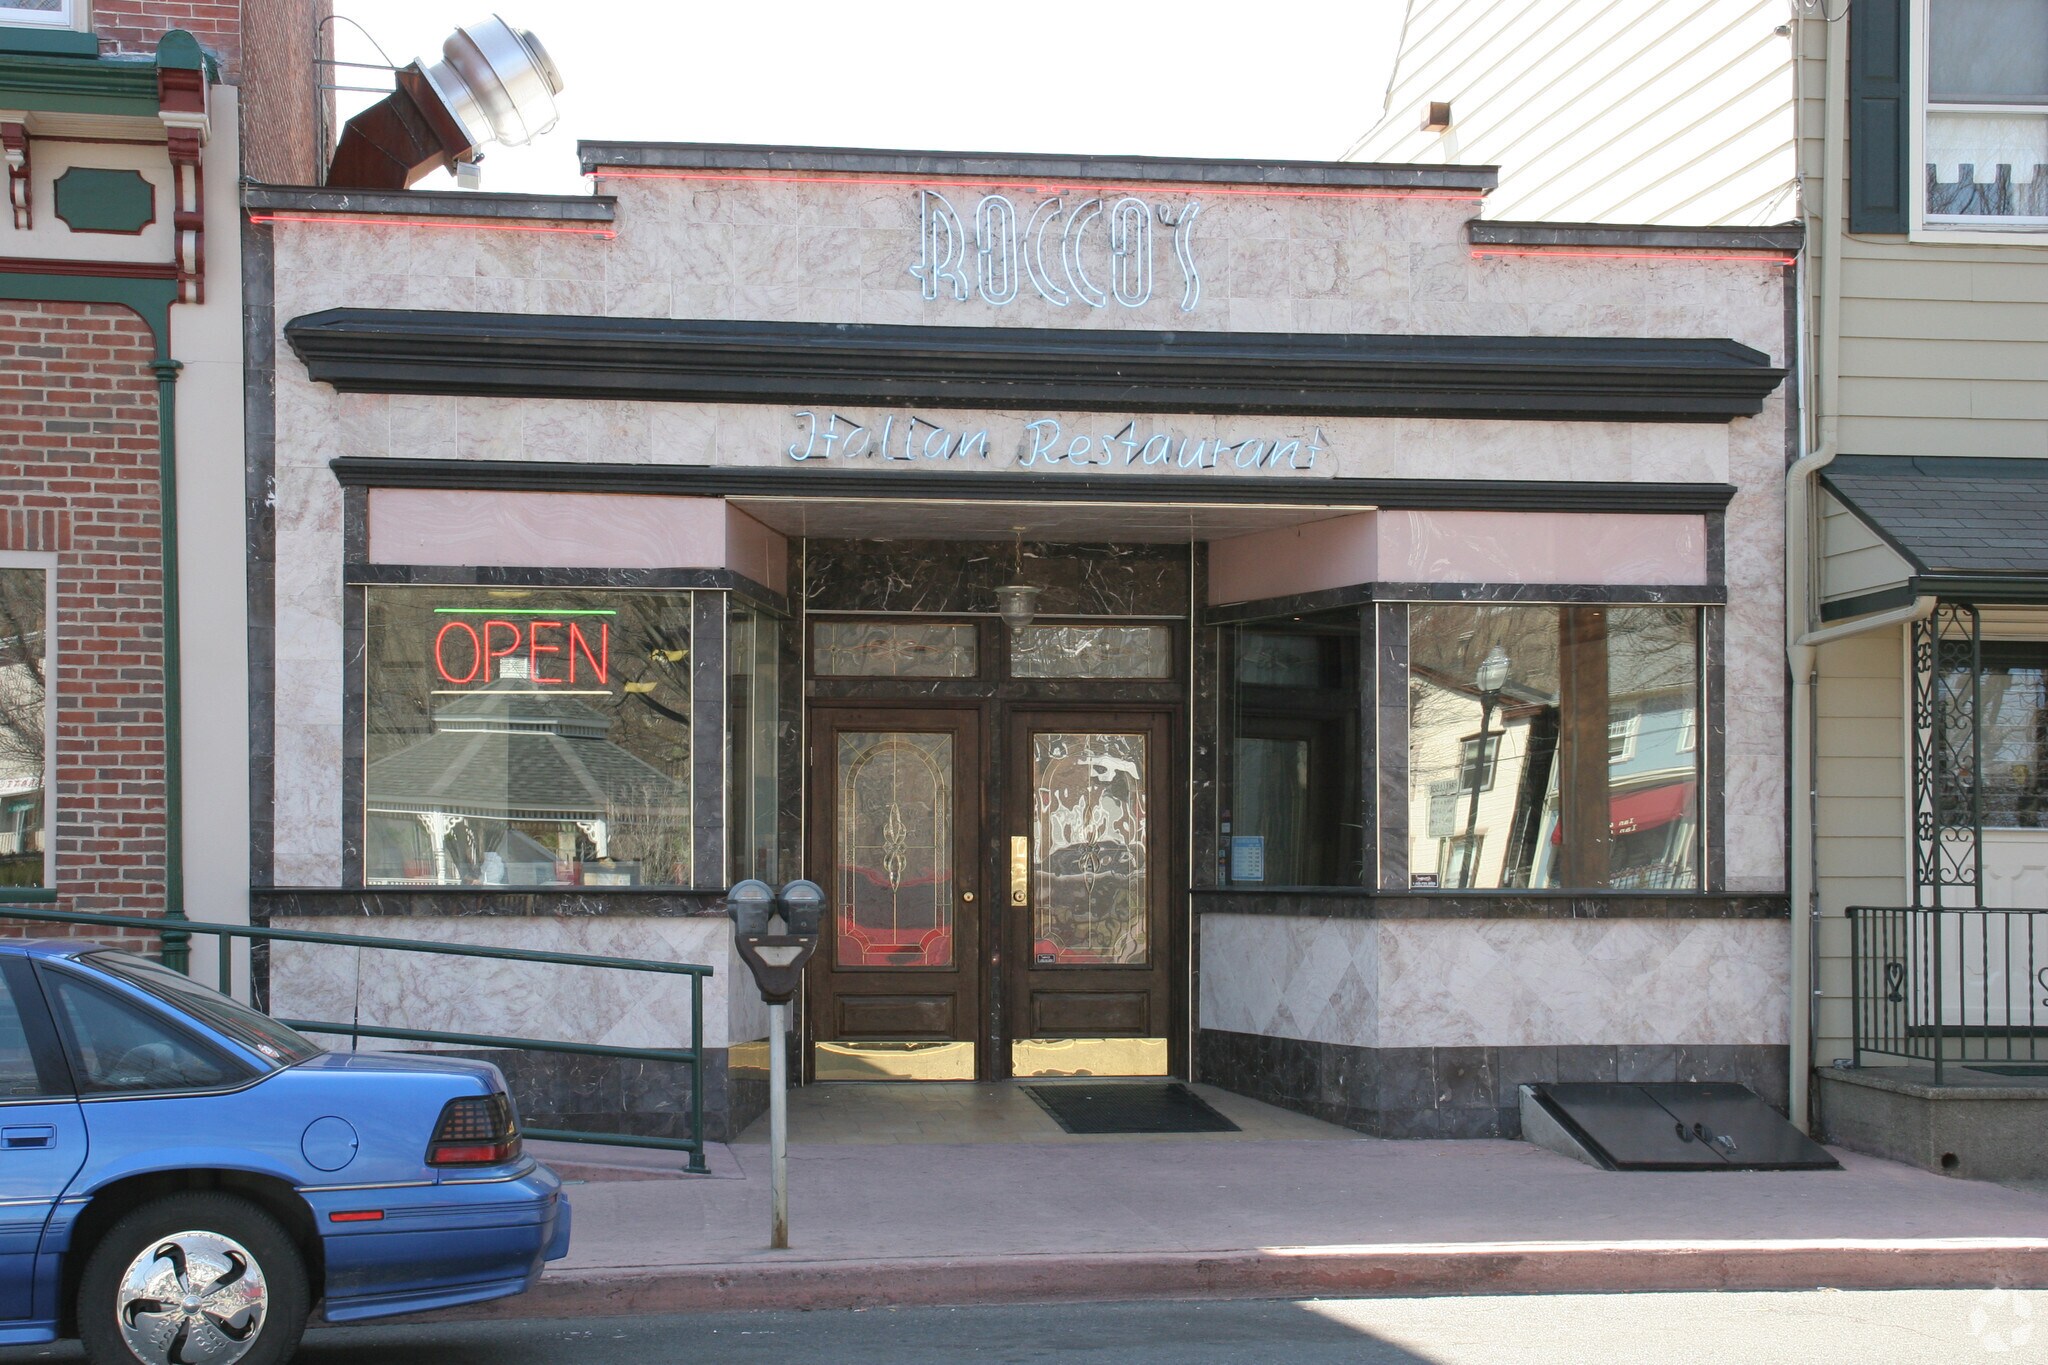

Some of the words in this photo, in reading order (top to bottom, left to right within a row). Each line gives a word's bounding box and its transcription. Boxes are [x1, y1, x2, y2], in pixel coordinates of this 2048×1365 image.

[789, 411, 988, 461] Italian
[1019, 419, 1325, 470] Restaurant
[434, 620, 609, 685] OPEN
